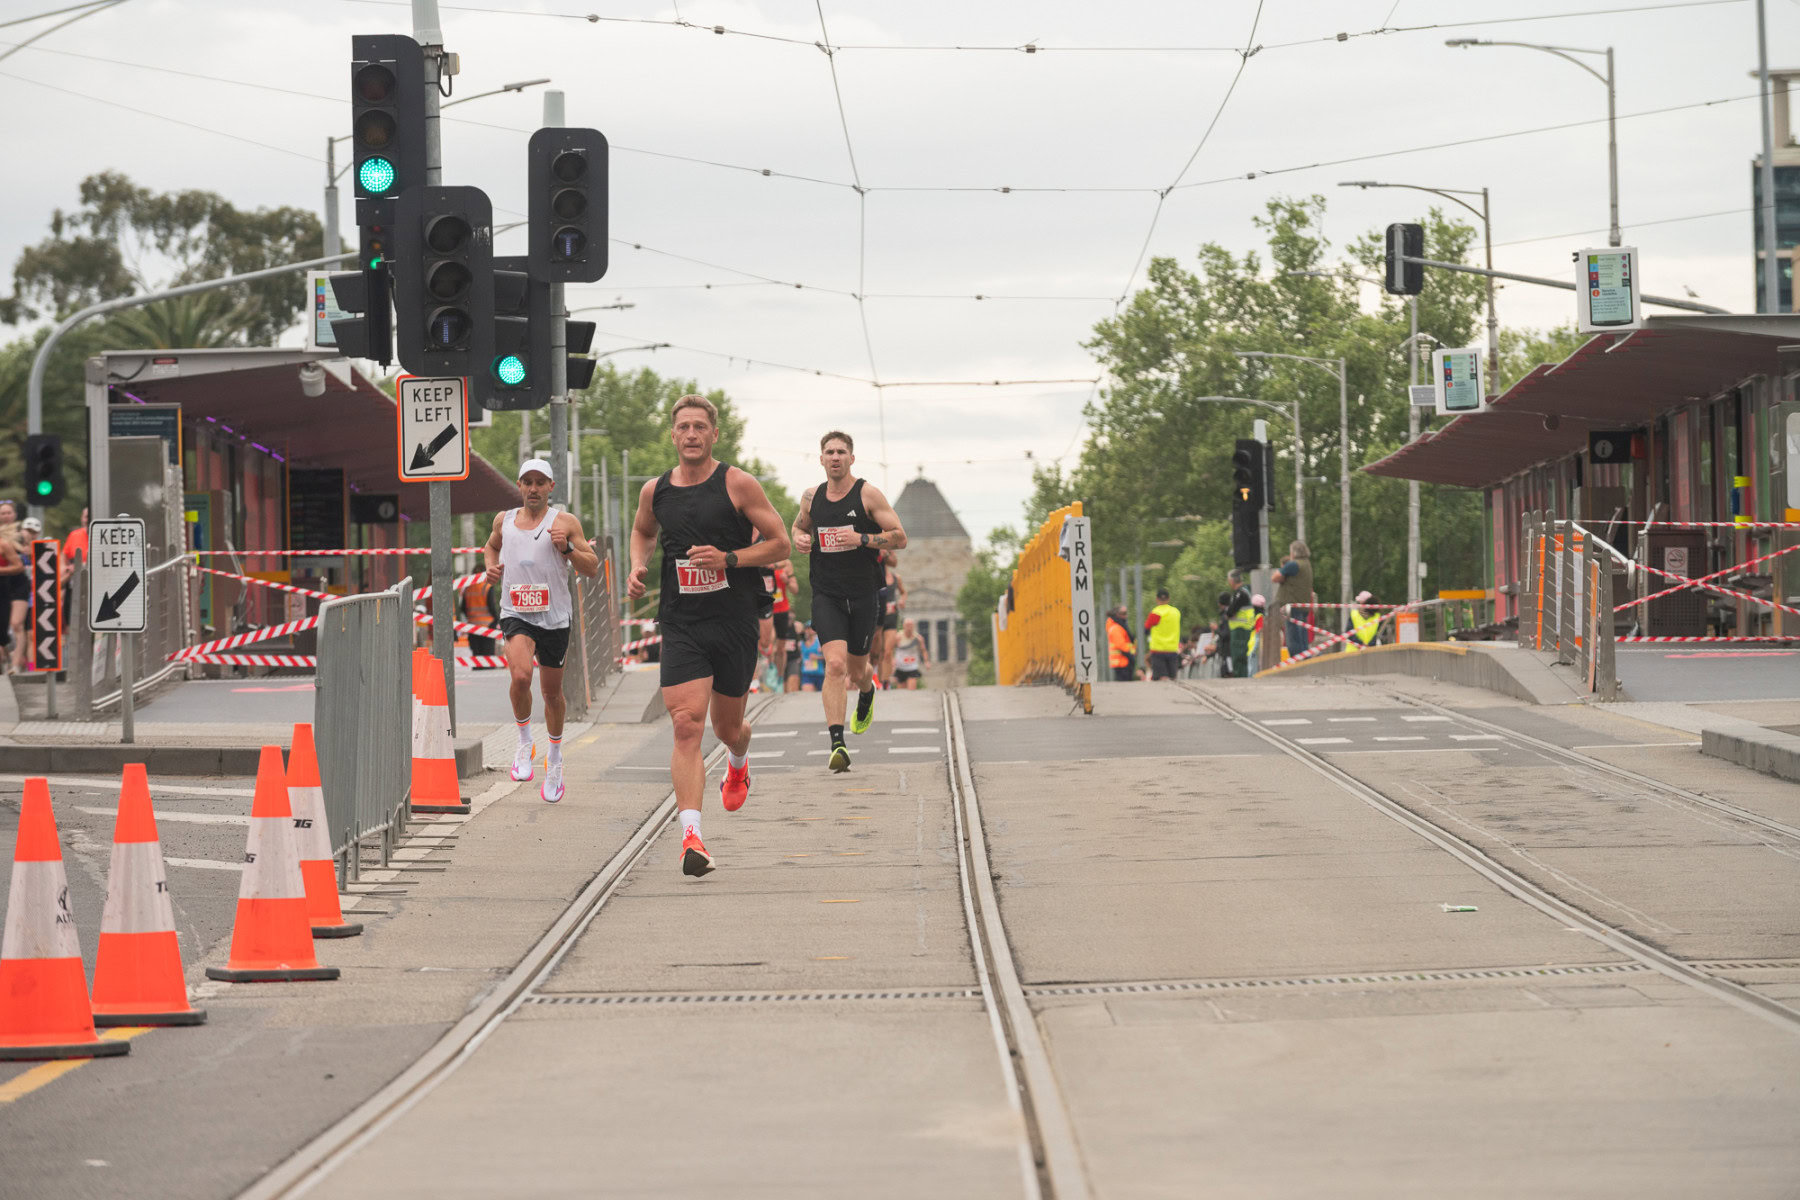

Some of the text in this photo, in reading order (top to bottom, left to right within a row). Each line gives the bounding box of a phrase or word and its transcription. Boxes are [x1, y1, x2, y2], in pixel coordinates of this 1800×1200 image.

[413, 387, 453, 402] KEEP
[415, 407, 452, 422] LEFT
[100, 528, 135, 545] KEEP
[102, 552, 134, 568] LEFT
[685, 568, 718, 585] 7709
[515, 591, 543, 606] 7966
[1075, 524, 1092, 677] TRAM ONLY
